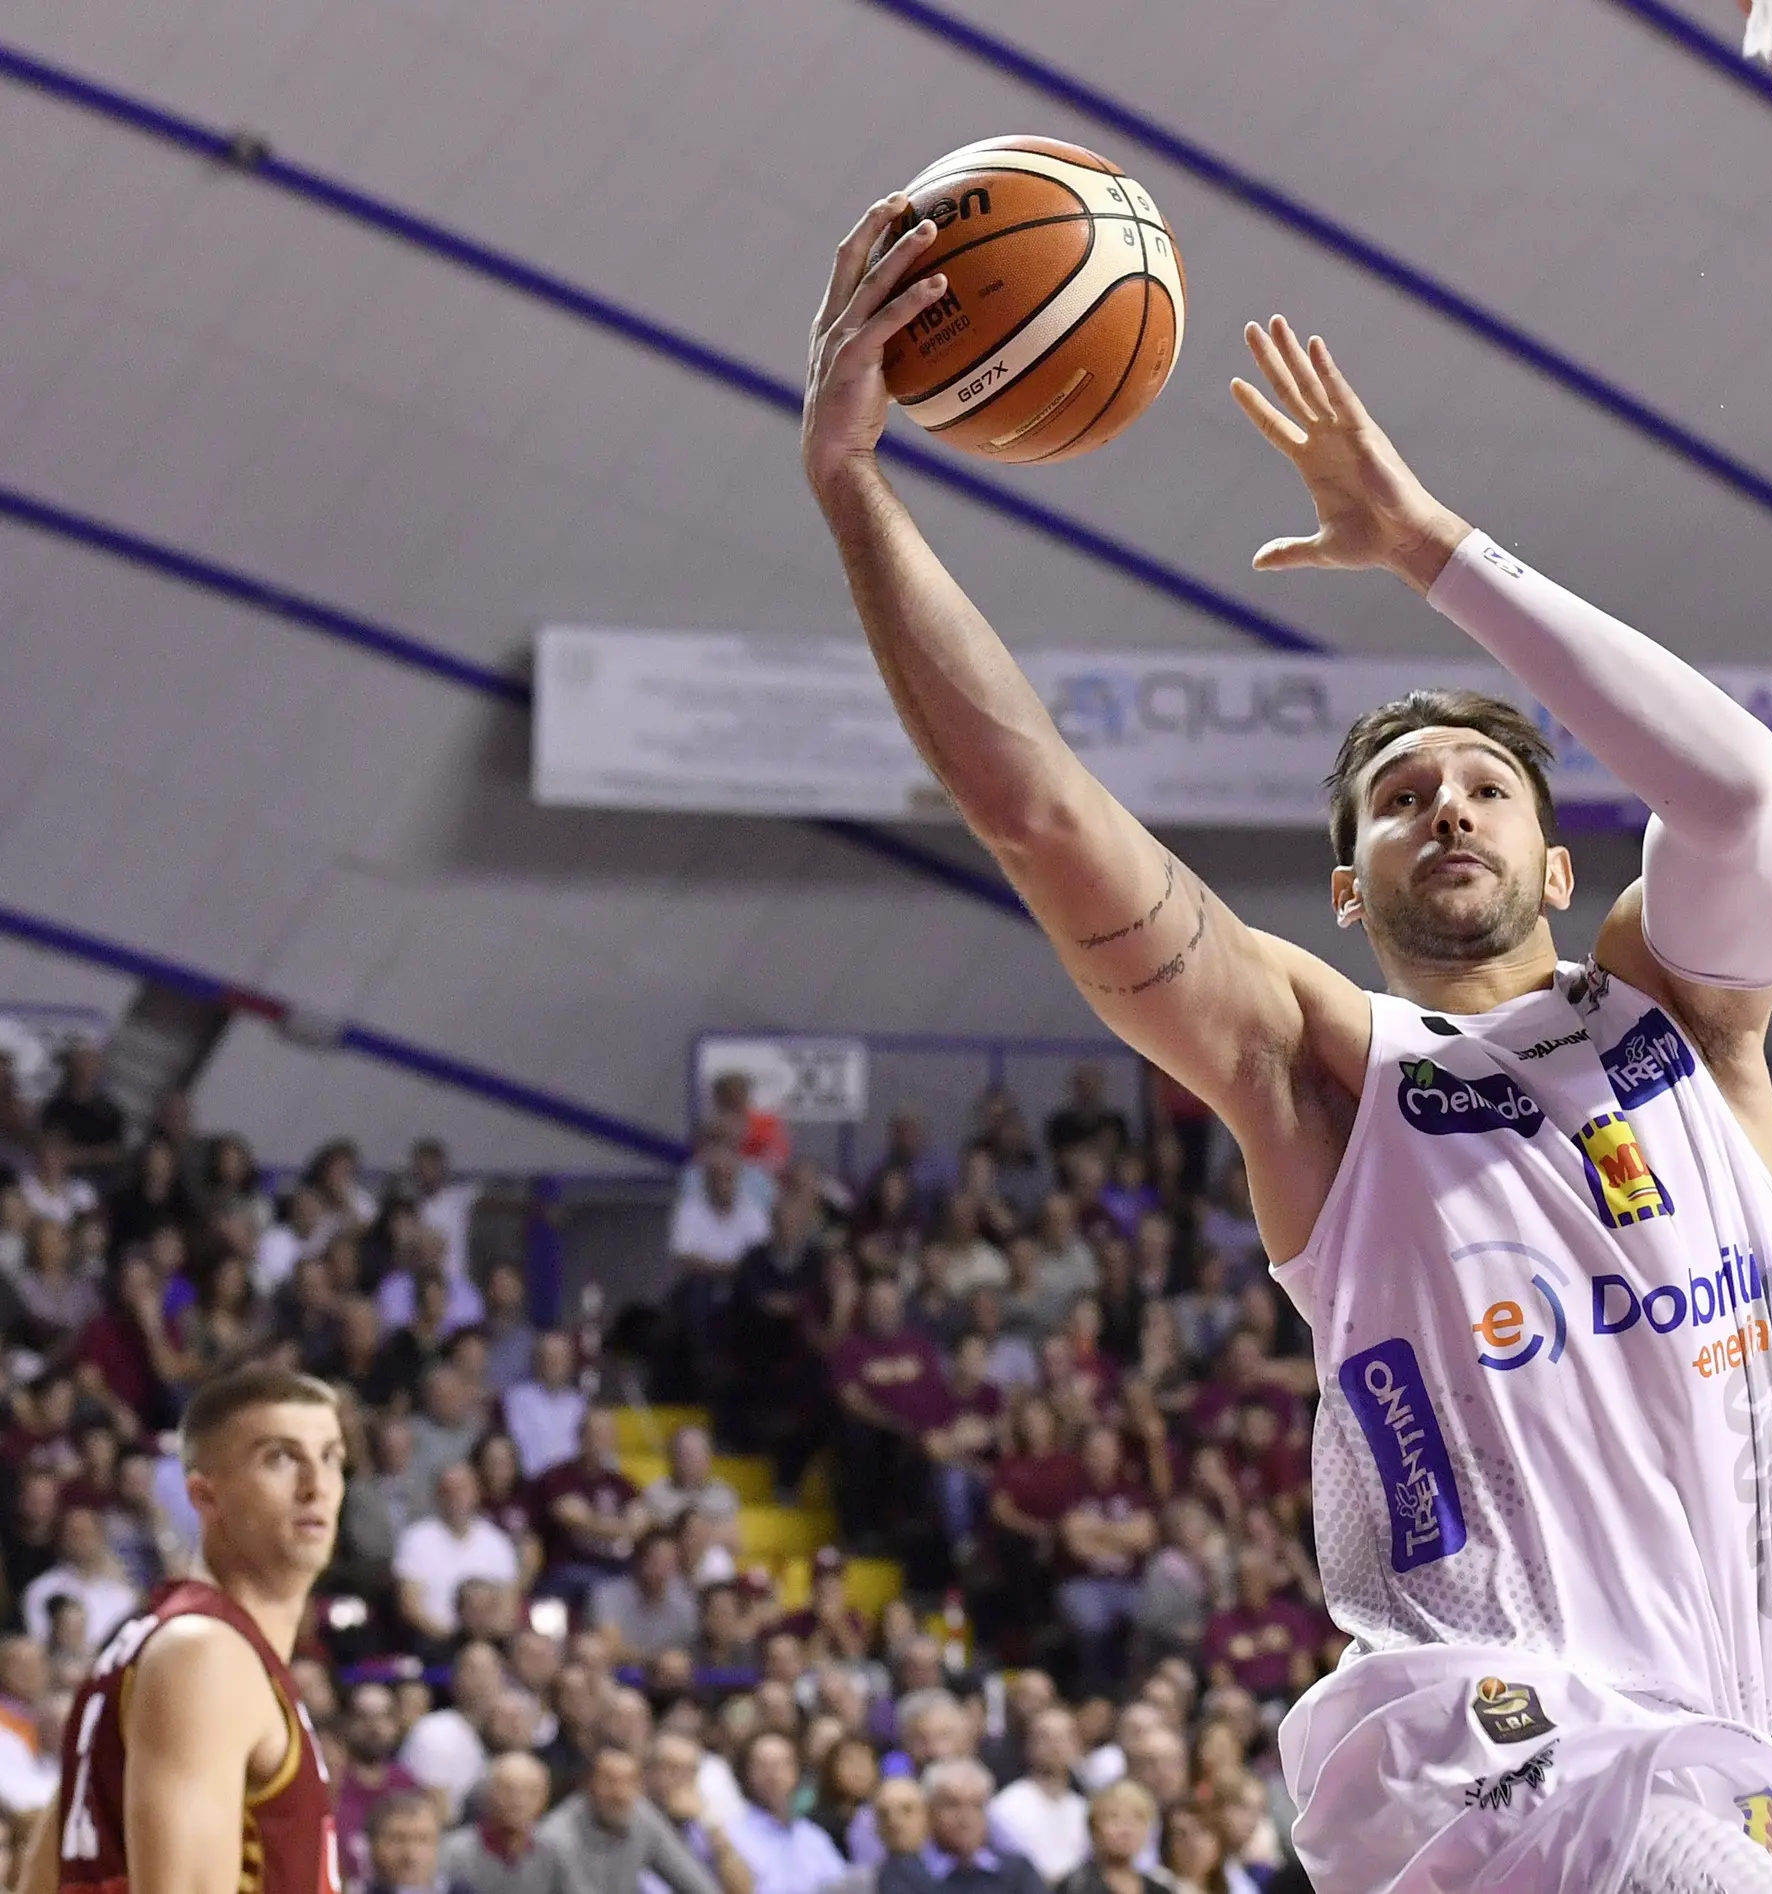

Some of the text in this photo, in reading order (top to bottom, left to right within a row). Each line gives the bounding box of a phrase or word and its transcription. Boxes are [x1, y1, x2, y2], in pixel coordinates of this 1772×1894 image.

[958, 361, 1009, 403] GG7X
[1364, 1360, 1441, 1557] TRENTINO
[1494, 1712, 1536, 1733] LBA
